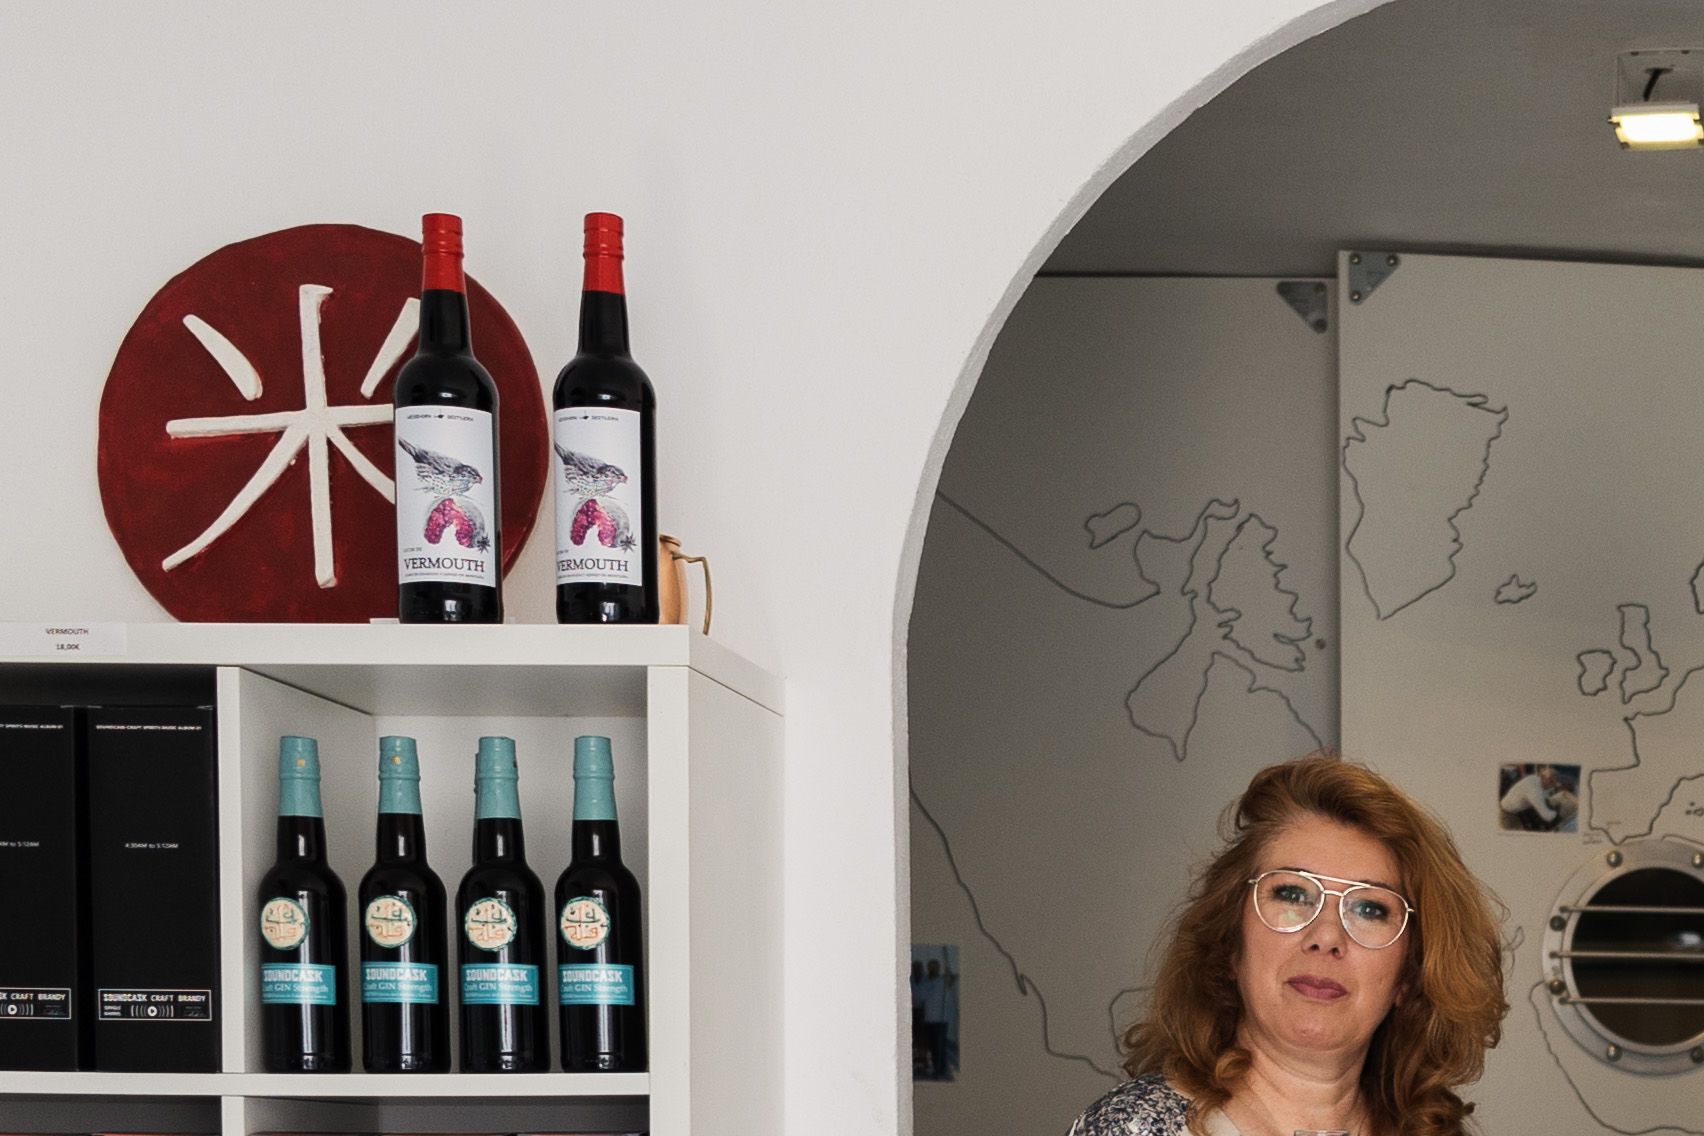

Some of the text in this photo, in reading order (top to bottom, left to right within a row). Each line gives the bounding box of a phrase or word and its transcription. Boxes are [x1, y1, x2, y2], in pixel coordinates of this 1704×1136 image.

[404, 557, 485, 573] VERMOUTH
[556, 557, 629, 572] VERMOUTH
[264, 969, 323, 982] SOUNDCASK
[365, 968, 427, 981] SOUNDCASK
[465, 969, 528, 982] SOUNDCASK
[562, 969, 622, 982] SOUNDCASK
[274, 983, 291, 991] GIN
[378, 982, 396, 991] GIN
[478, 983, 497, 991] GIN
[574, 983, 592, 991] GIN
[38, 993, 66, 1001] BRANDY
[150, 994, 174, 1002] CRAFT
